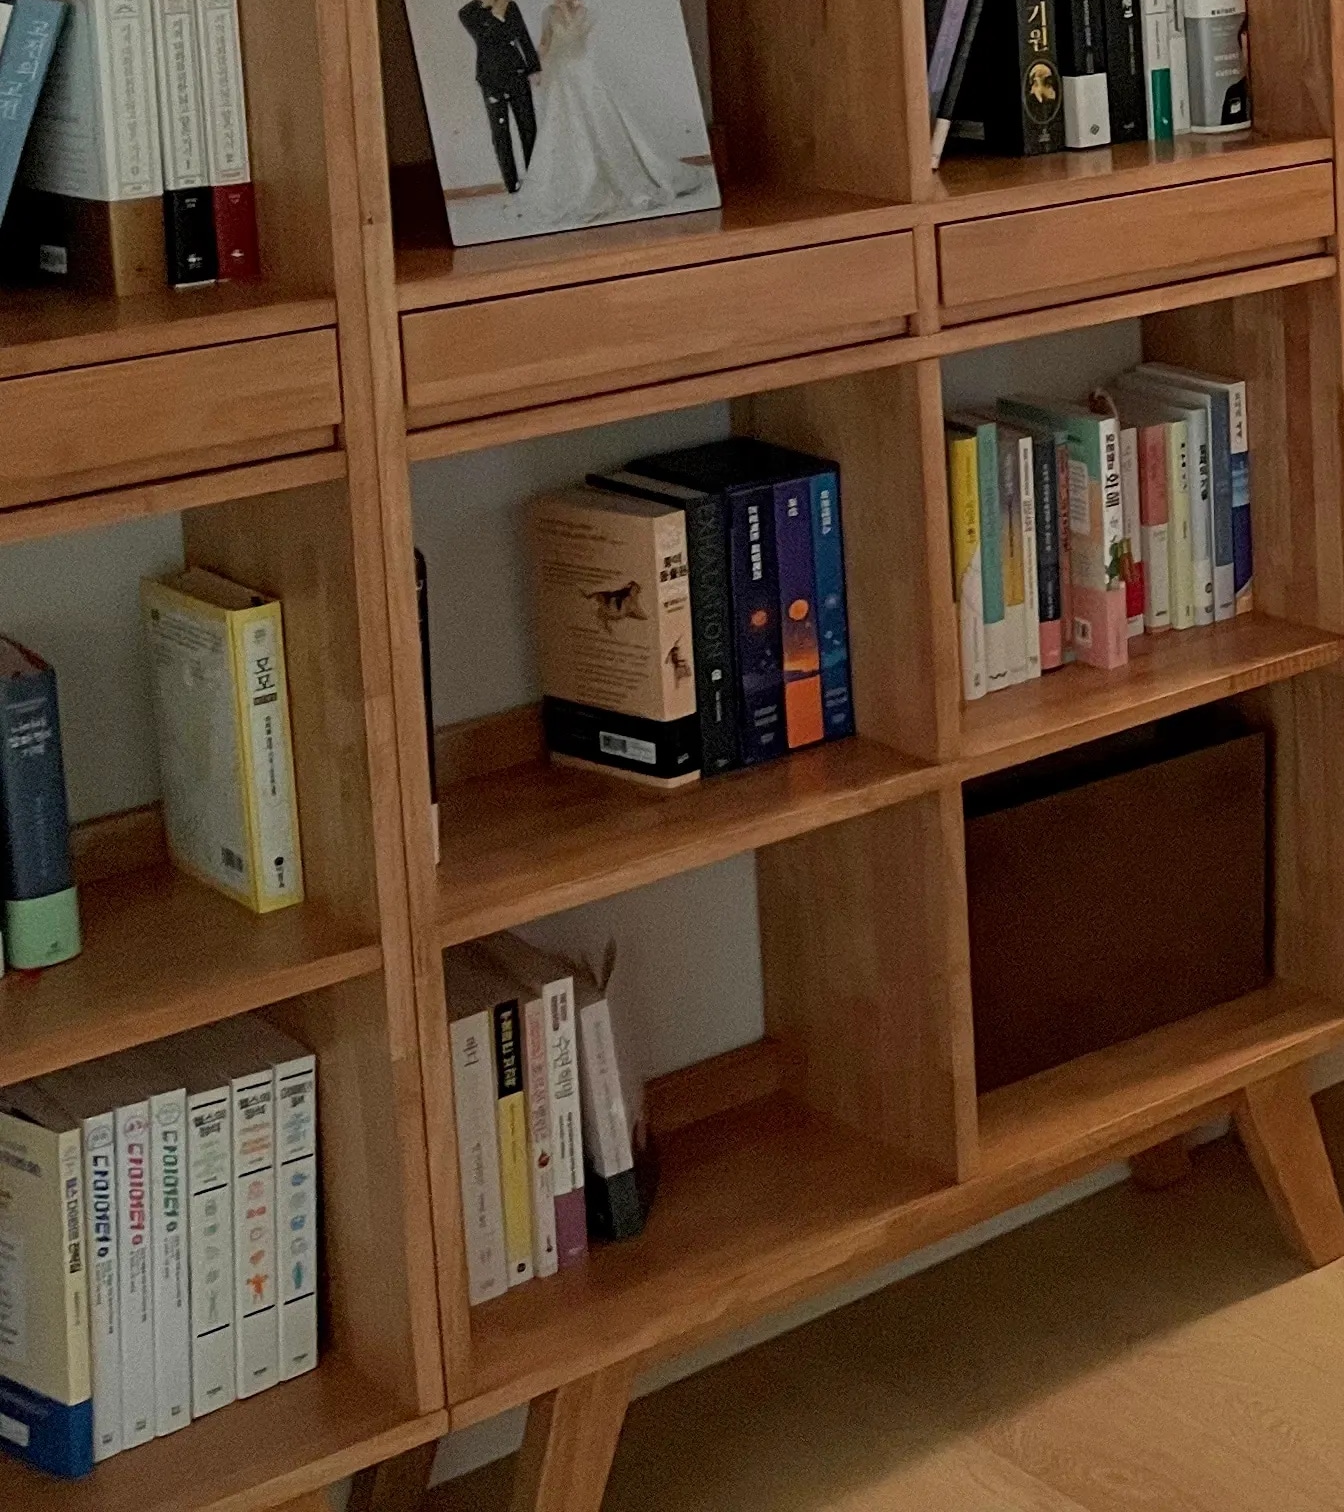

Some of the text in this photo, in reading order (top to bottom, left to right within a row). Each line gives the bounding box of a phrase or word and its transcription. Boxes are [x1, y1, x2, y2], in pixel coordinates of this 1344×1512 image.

[1028, 3, 1049, 53] 기원
[697, 503, 723, 658] EXHALATION
[92, 1154, 112, 1243] 다이어터
[127, 1142, 146, 1231] 다이어터
[161, 1129, 179, 1218] 다이어터
